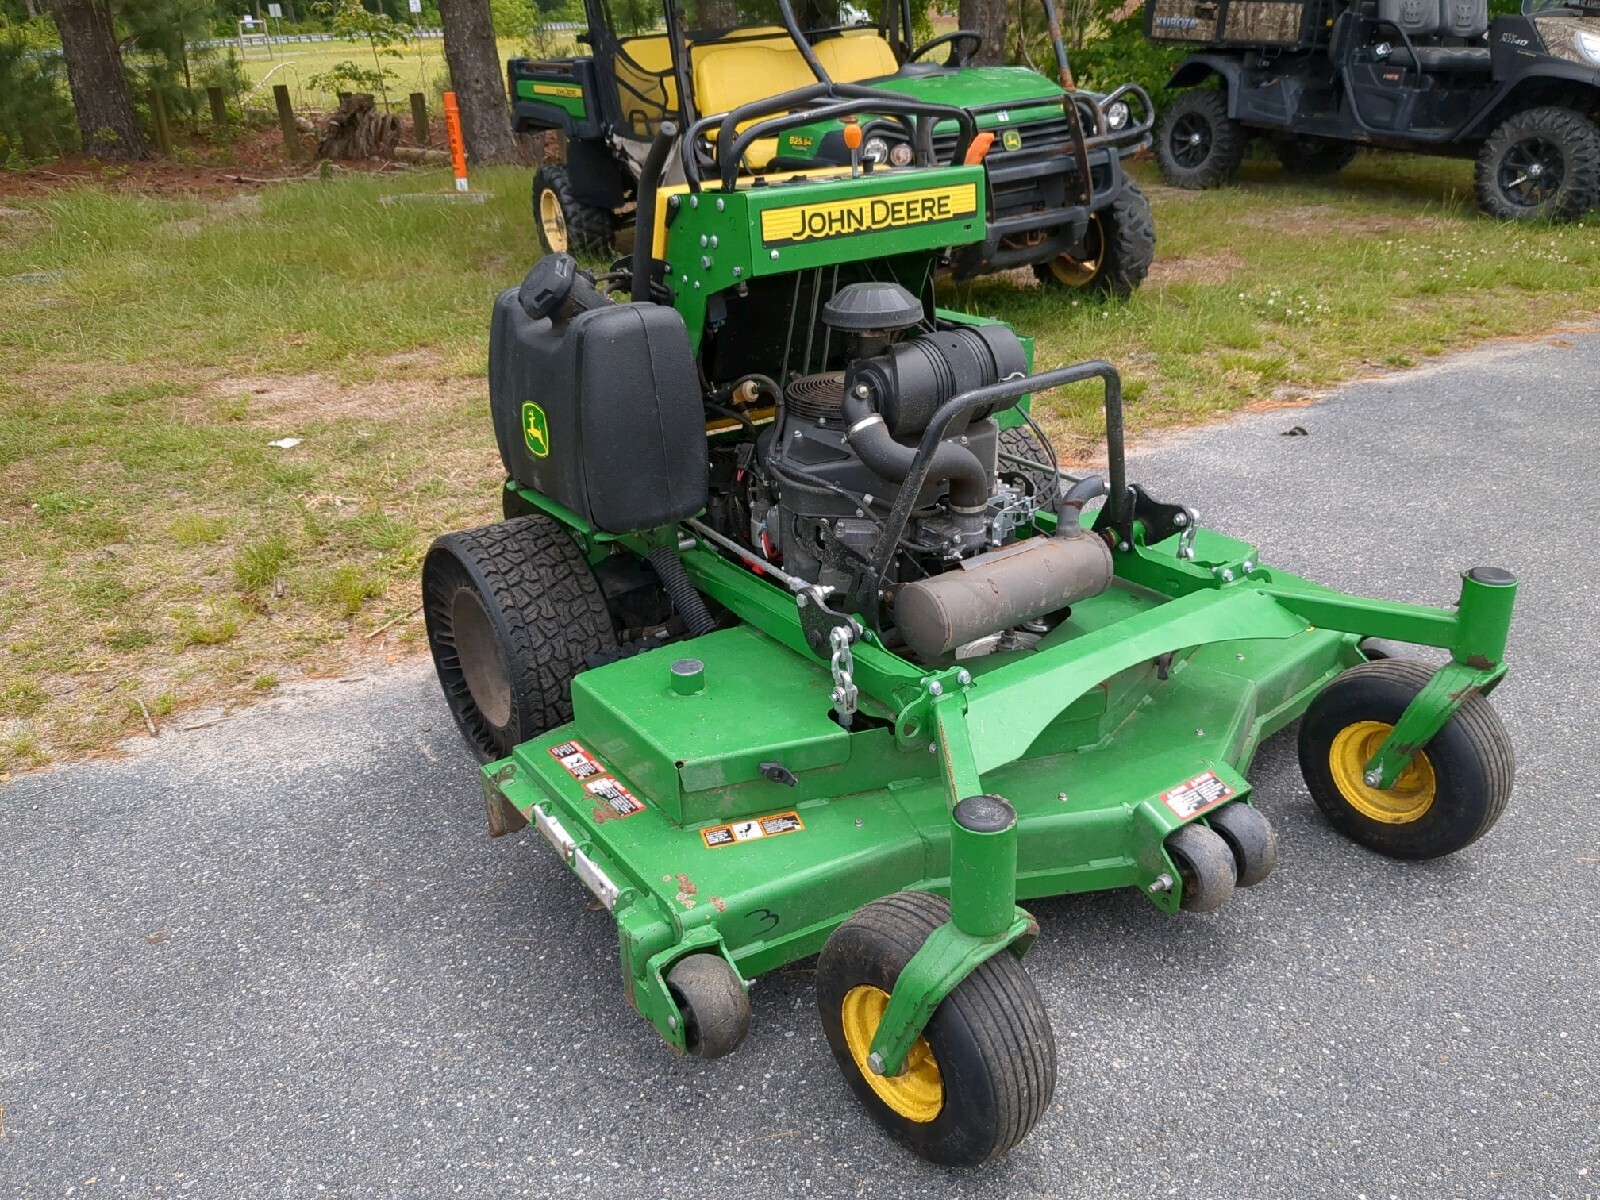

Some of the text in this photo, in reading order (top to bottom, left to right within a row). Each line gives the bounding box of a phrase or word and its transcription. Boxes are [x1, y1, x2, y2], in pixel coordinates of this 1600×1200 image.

[1156, 16, 1196, 27] KUBOTA
[792, 195, 951, 238] JOHN DEERE
[743, 908, 780, 938] 3
